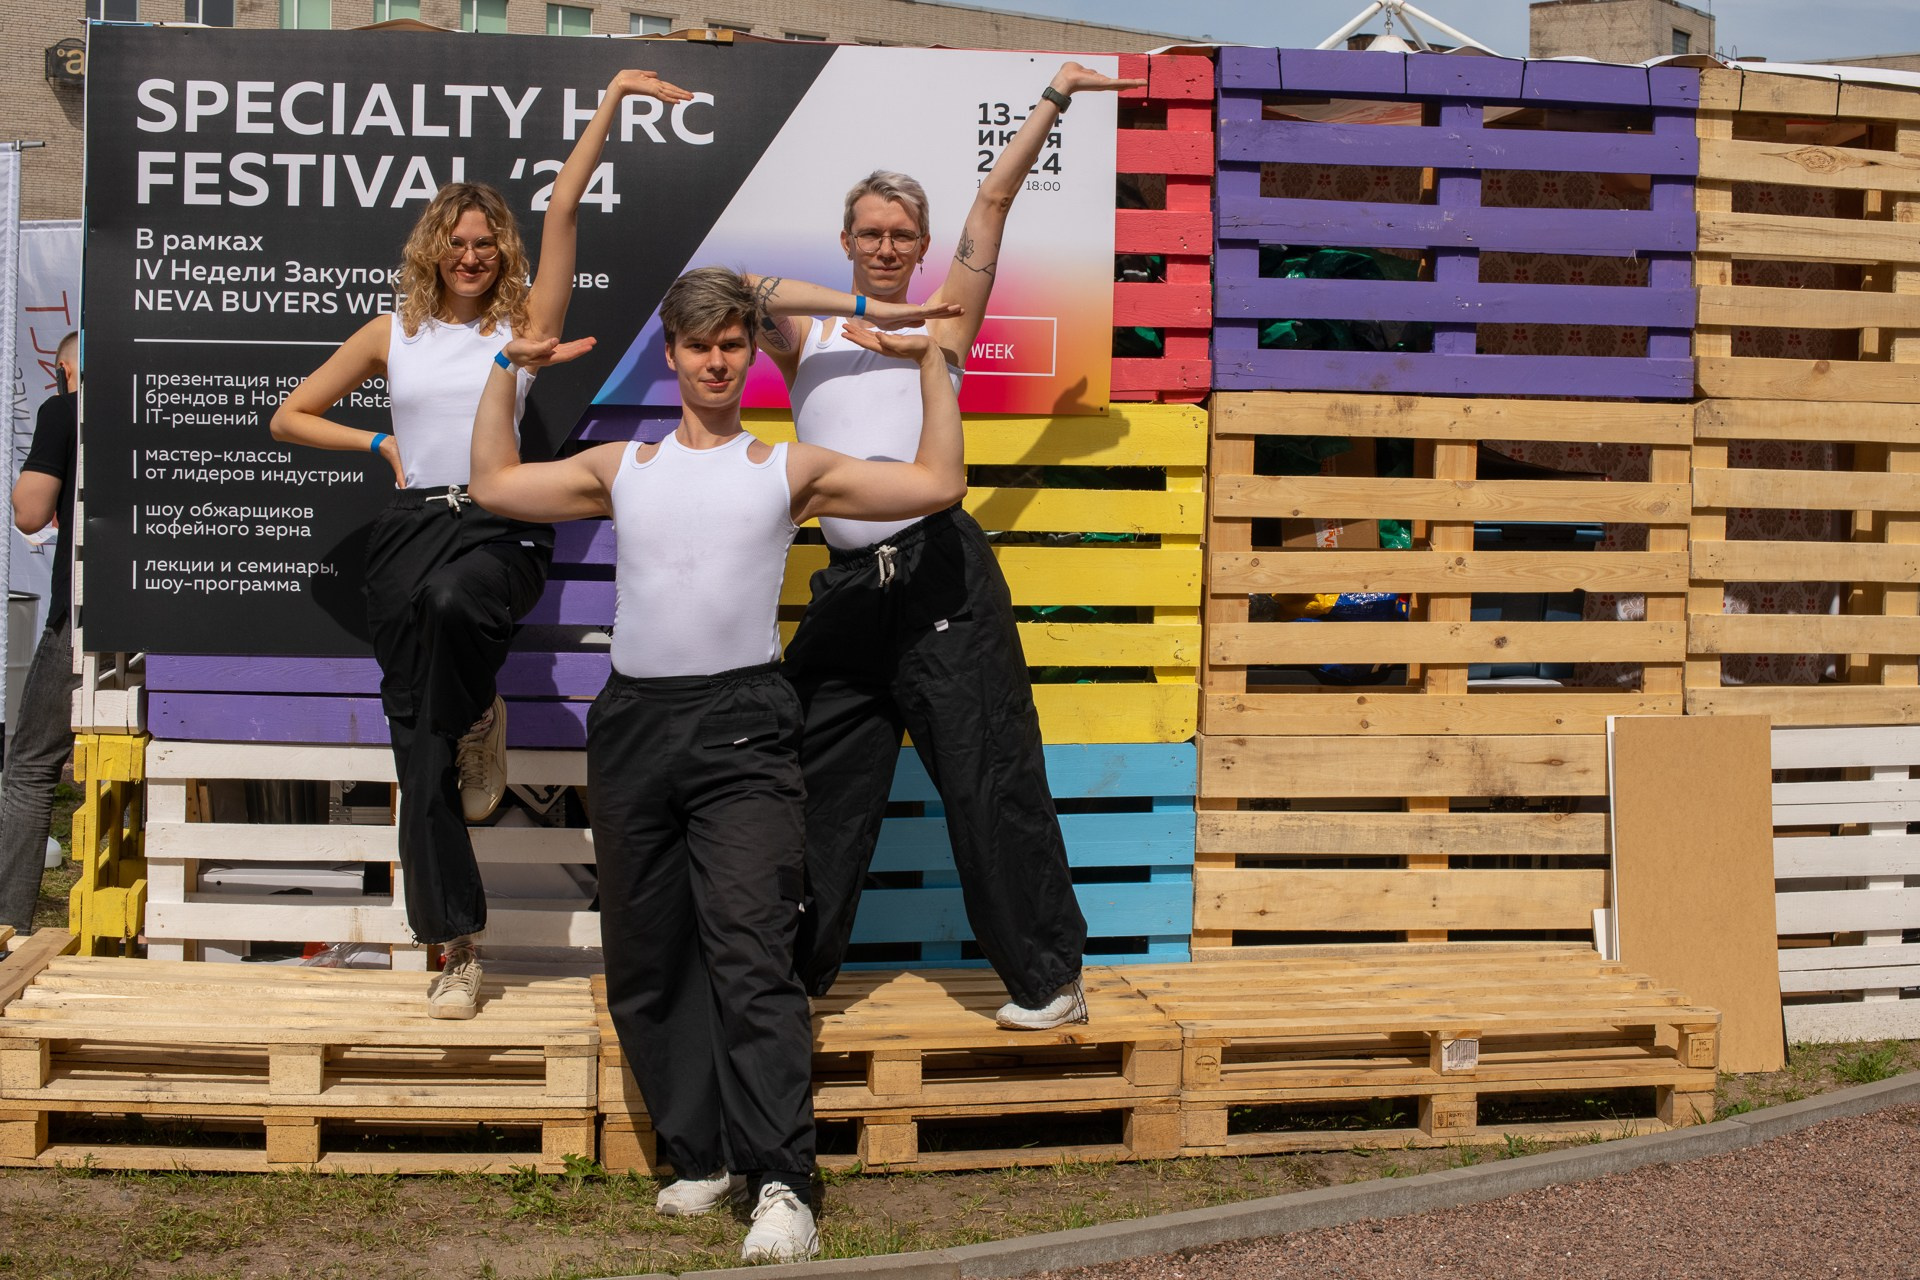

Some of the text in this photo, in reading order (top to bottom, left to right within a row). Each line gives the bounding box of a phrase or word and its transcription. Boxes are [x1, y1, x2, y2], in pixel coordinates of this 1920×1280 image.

[137, 79, 714, 145] SPECIALTY HRC
[978, 129, 1062, 148] июя
[977, 150, 1062, 175] 24
[1026, 181, 1061, 191] 18:00
[137, 228, 263, 255] В рамках
[136, 259, 163, 280] IV
[172, 260, 275, 284] Недели
[285, 261, 401, 289] Закупок
[135, 289, 409, 315] NEVA BUYERS WEE
[971, 343, 1014, 359] WEEK
[146, 374, 269, 391] презентация
[145, 391, 228, 408] брендов
[235, 394, 245, 405] в
[350, 392, 391, 408] Reta
[146, 408, 258, 427] IT-решений
[146, 450, 291, 465] мастер-классы
[146, 468, 363, 486] от лидеров индустрии
[146, 502, 314, 521] шоу обжарщиков
[146, 520, 312, 540] кофейного зерна
[145, 561, 339, 579] лекции и семинары,
[146, 579, 301, 594] шоу-программа
